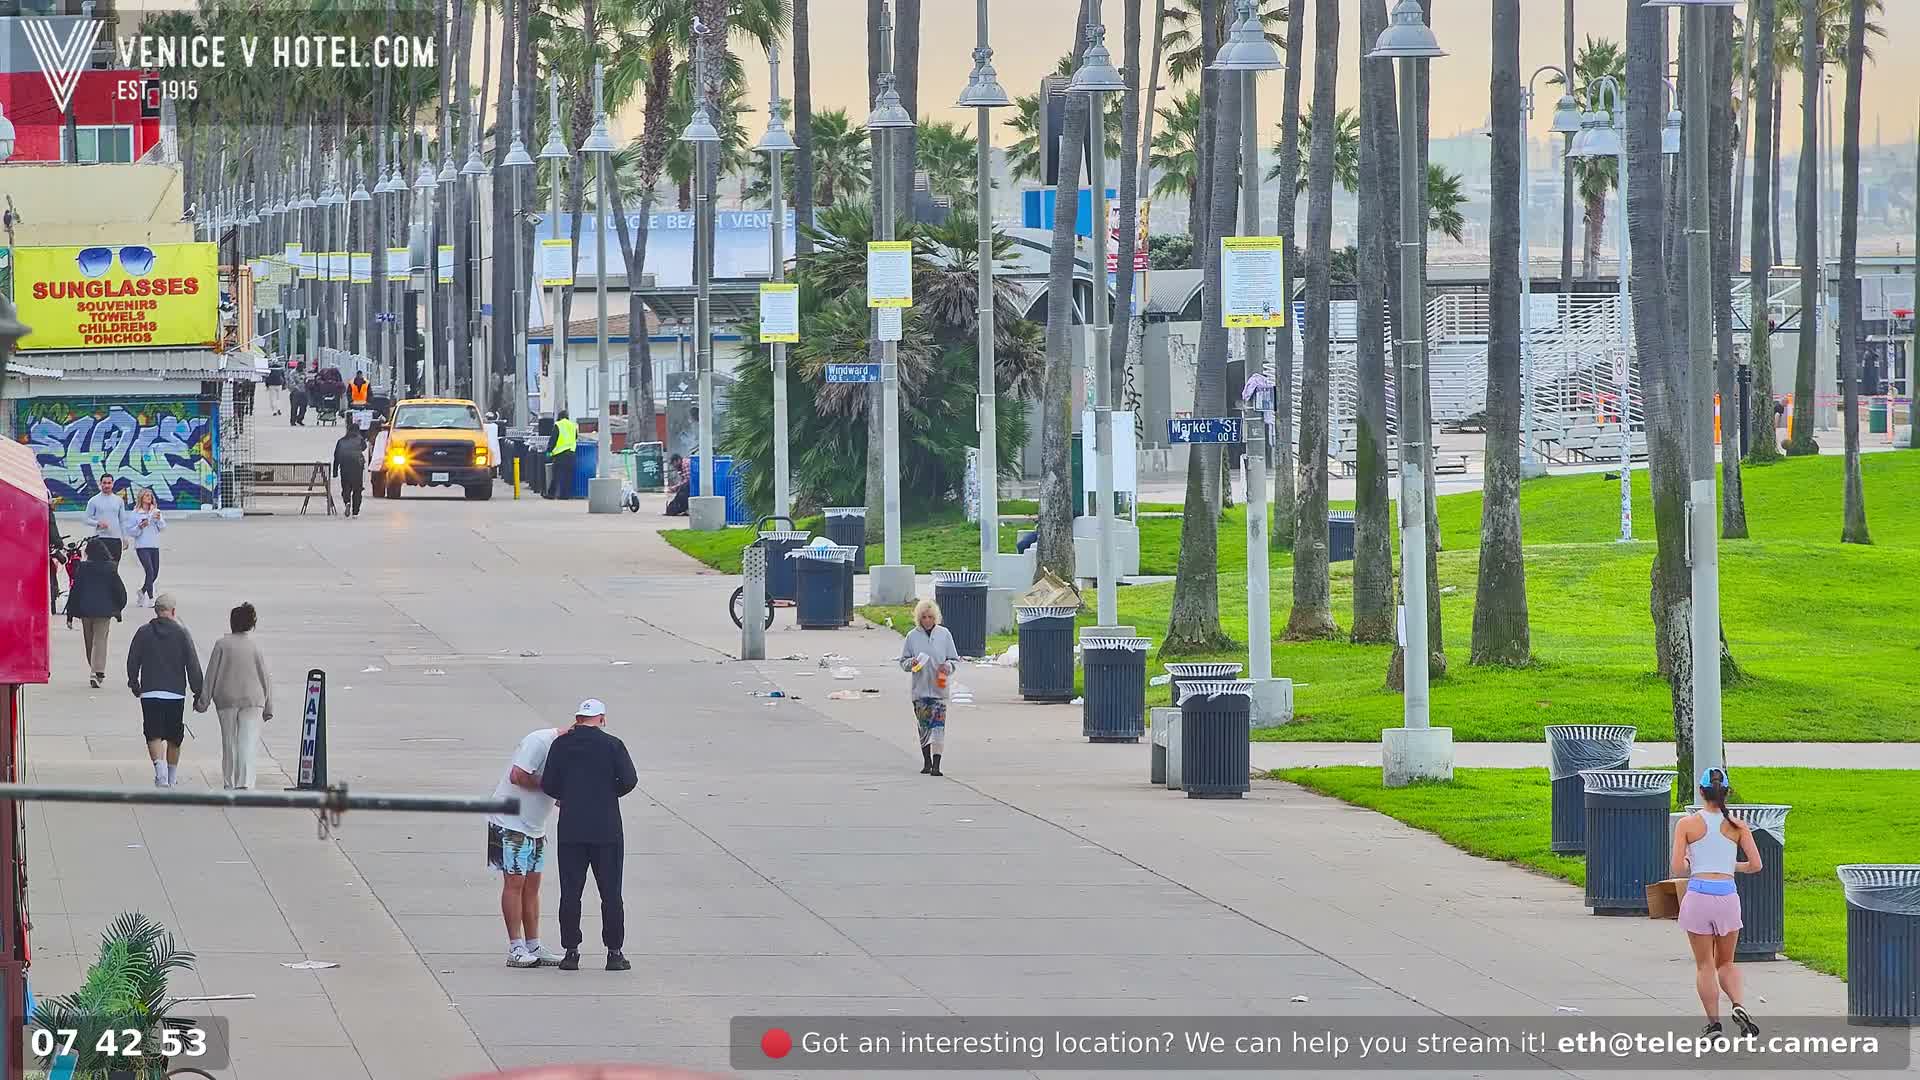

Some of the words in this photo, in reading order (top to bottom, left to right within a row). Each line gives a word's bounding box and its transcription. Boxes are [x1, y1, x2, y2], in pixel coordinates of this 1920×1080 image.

[666, 214, 722, 229] BEAH
[32, 277, 199, 300] SUNGLASSES
[77, 300, 157, 312] SOUVENIRS
[88, 311, 146, 322] TOWELS
[78, 321, 157, 334] CHILDRENS
[84, 333, 152, 345] PONCHOS
[828, 365, 868, 376] Windward
[1171, 420, 1211, 433] Market
[1224, 419, 1237, 433] St
[1217, 432, 1229, 442] 00
[1232, 432, 1237, 442] E
[302, 698, 317, 757] ATM
